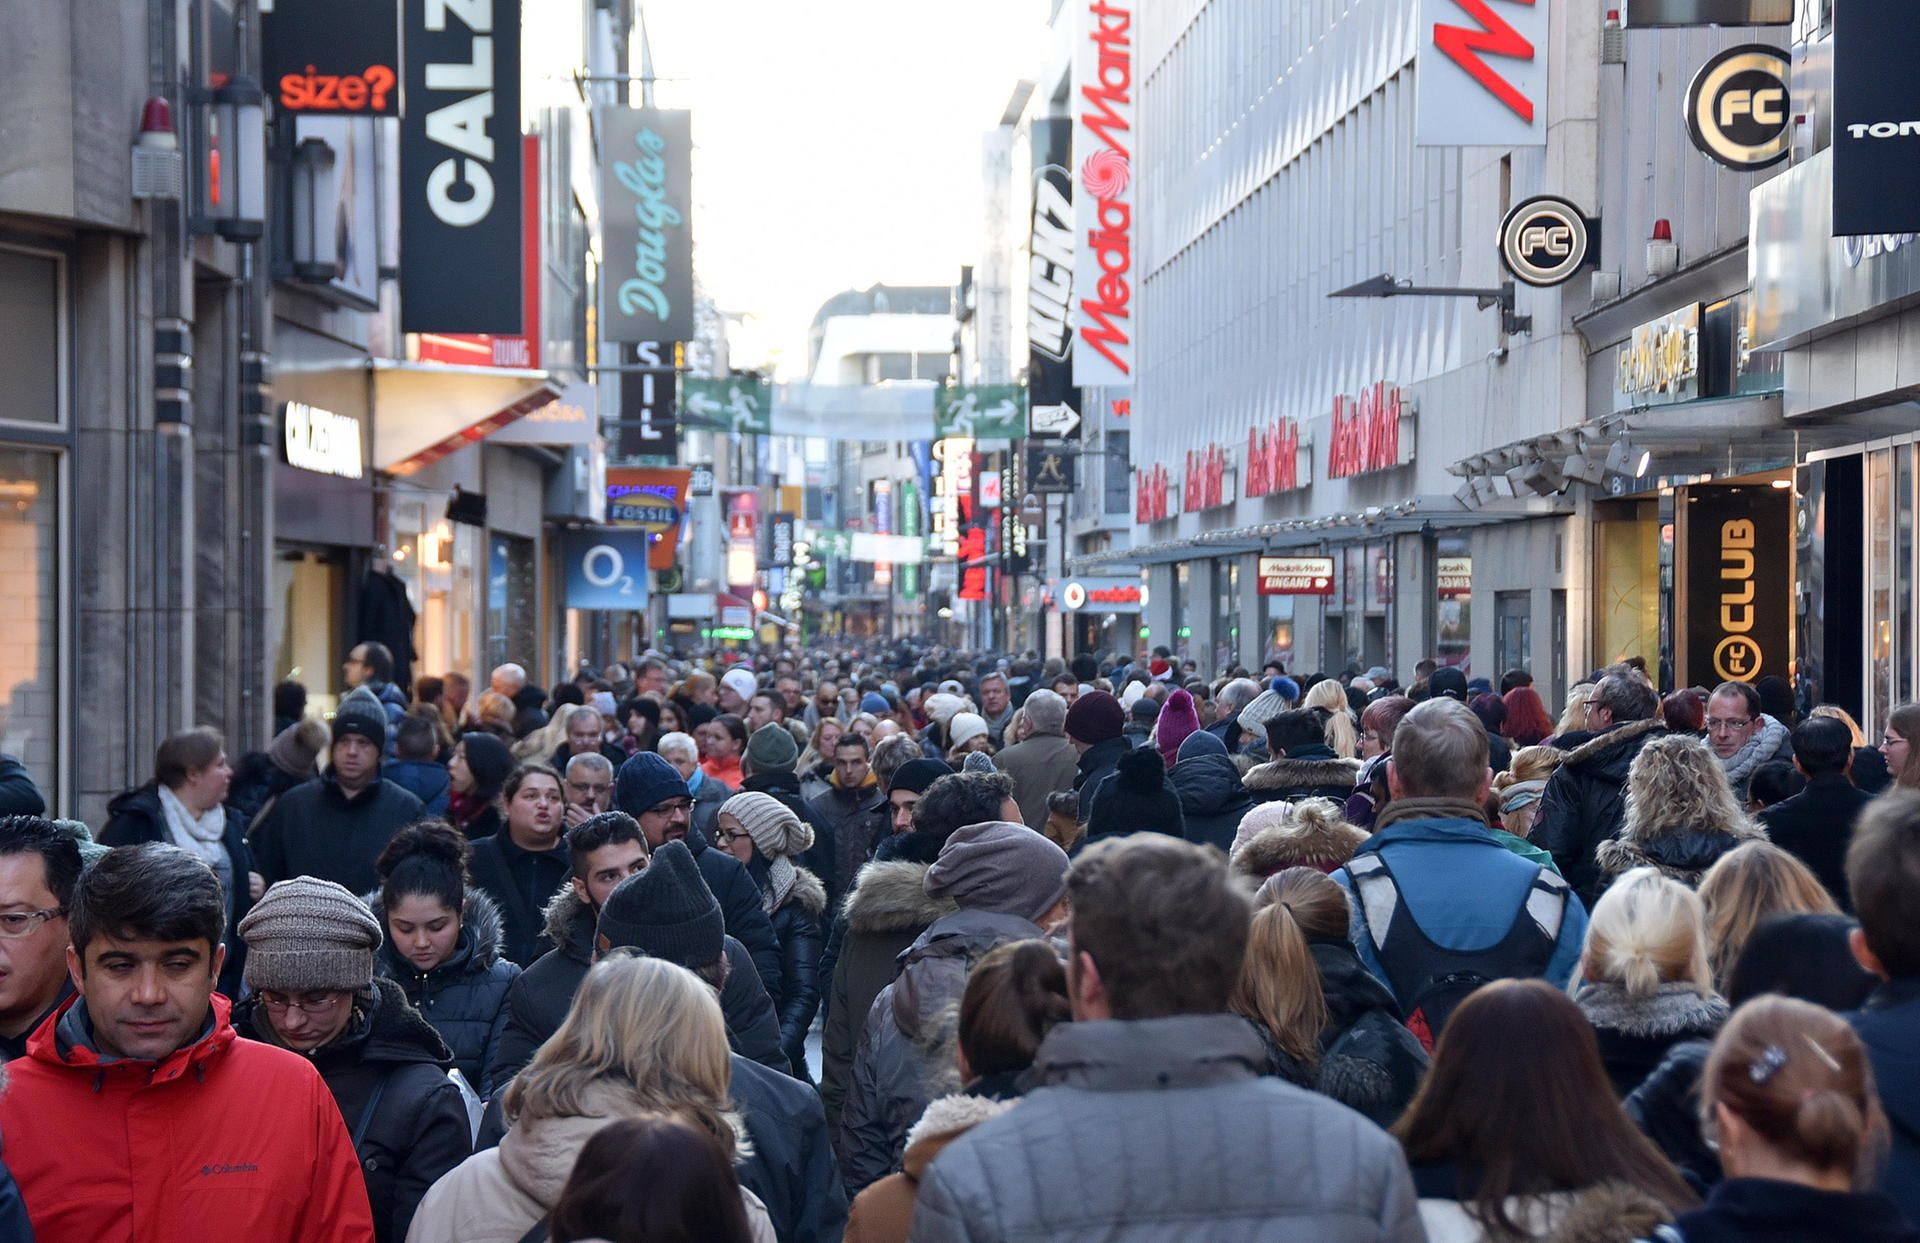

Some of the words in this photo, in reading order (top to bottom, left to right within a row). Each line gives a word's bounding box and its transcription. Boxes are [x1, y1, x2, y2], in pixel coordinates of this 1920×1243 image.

[280, 65, 395, 110] size?
[1720, 88, 1783, 126] FC
[613, 127, 683, 320] Douglas
[1522, 226, 1569, 256] FC
[612, 505, 674, 521] FOSSIL
[1264, 576, 1311, 589] EINGANG
[1721, 518, 1755, 633] CLUB
